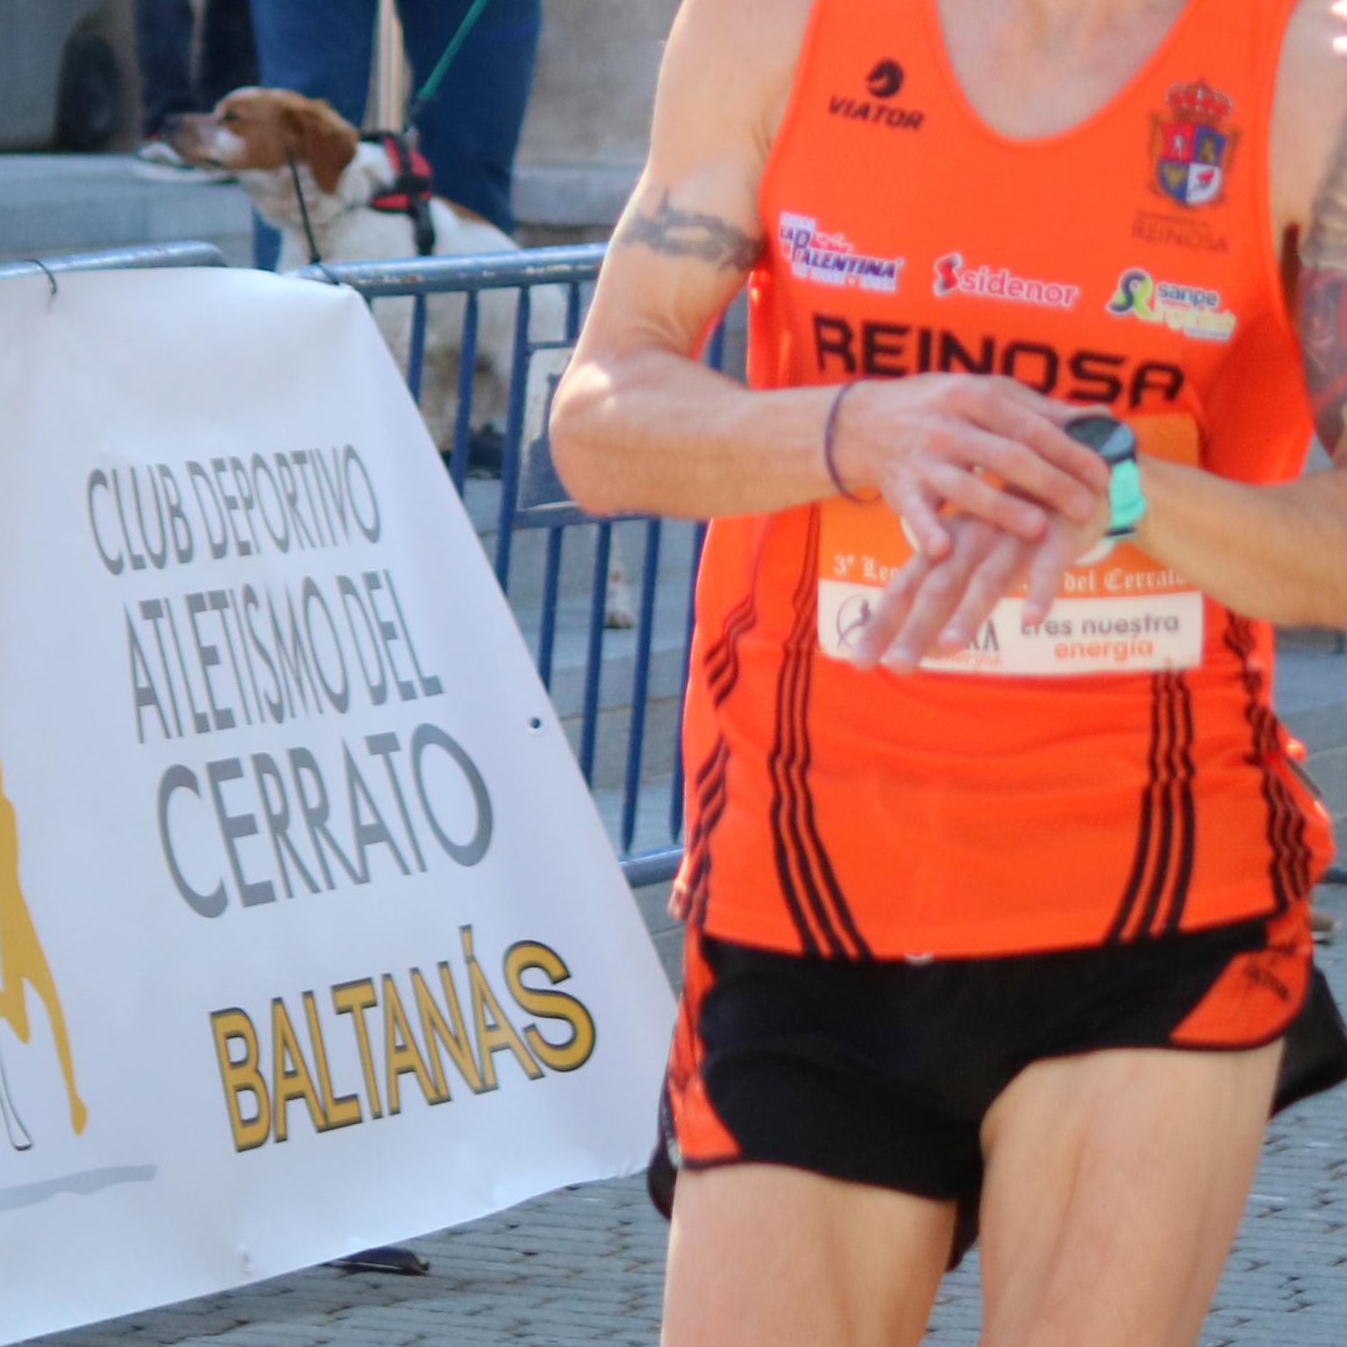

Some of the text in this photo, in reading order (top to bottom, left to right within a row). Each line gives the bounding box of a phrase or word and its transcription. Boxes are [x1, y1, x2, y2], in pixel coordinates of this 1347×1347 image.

[829, 95, 926, 130] VIATOR
[793, 227, 895, 279] PALENTINA
[960, 266, 1078, 306] sidenor
[1158, 282, 1218, 308] sanpe
[812, 312, 1185, 410] REINOSA
[86, 444, 381, 576] CLUB DEPORTIVO
[1064, 570, 1096, 591] del
[1081, 613, 1179, 636] nuestra
[123, 569, 444, 744] ATLETISMO DEL
[1054, 633, 1155, 666] energía
[157, 722, 493, 918] CERRATO
[209, 924, 596, 1153] BALTANÁS
